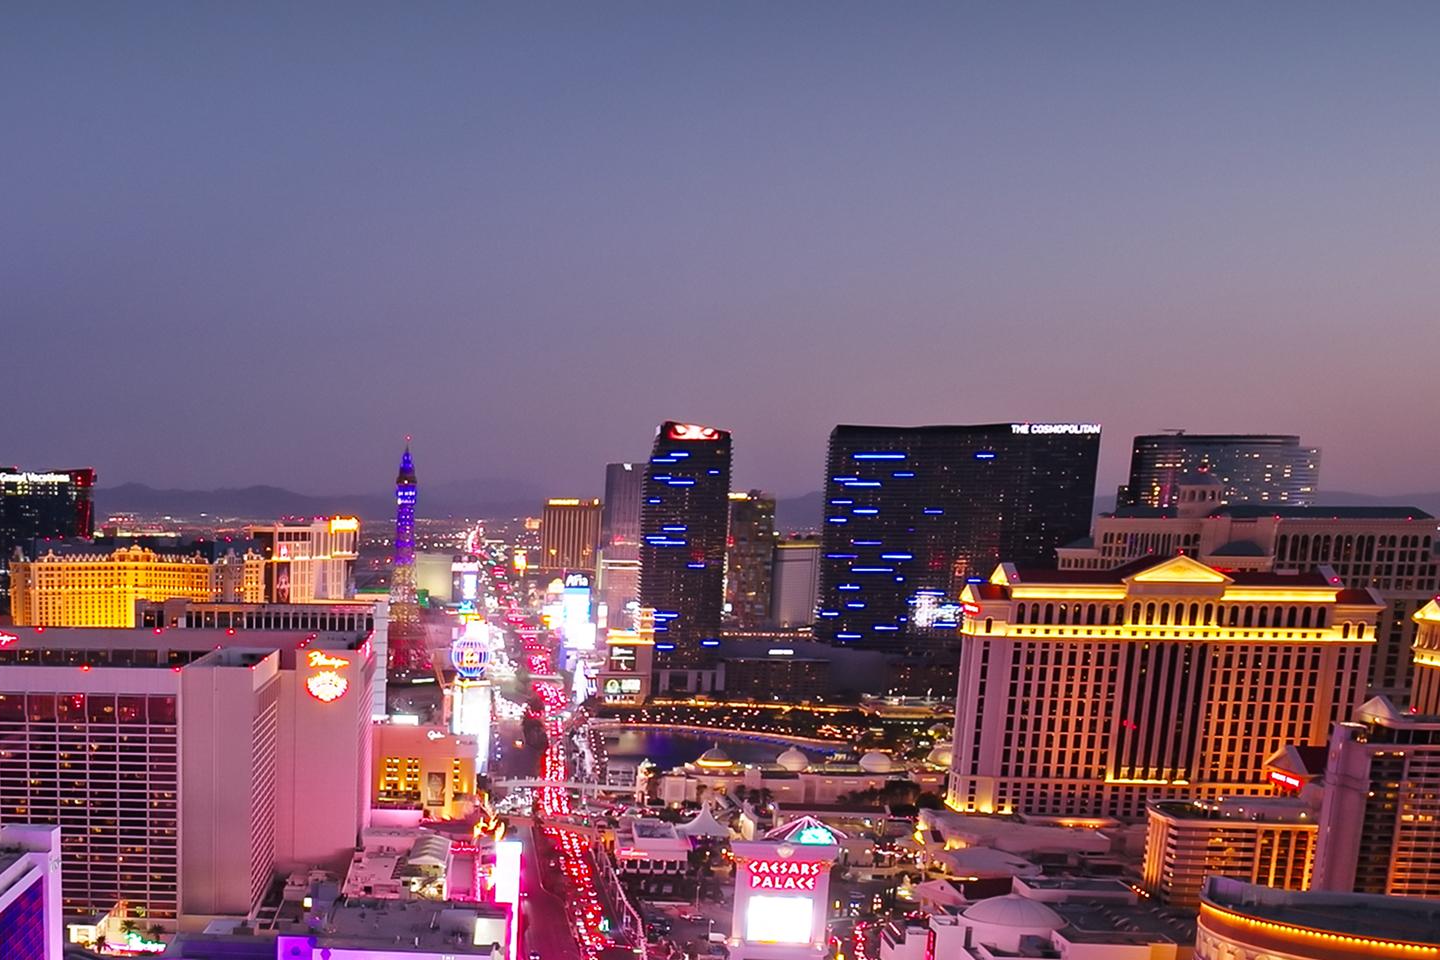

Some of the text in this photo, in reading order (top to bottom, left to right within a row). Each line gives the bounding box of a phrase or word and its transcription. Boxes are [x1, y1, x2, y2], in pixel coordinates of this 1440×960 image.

[1011, 424, 1101, 434] THE COSMOPOLITAN
[0, 472, 27, 482] Grand
[27, 472, 70, 482] Vacations
[749, 860, 820, 876] CAESARS
[751, 875, 816, 890] PALACE
